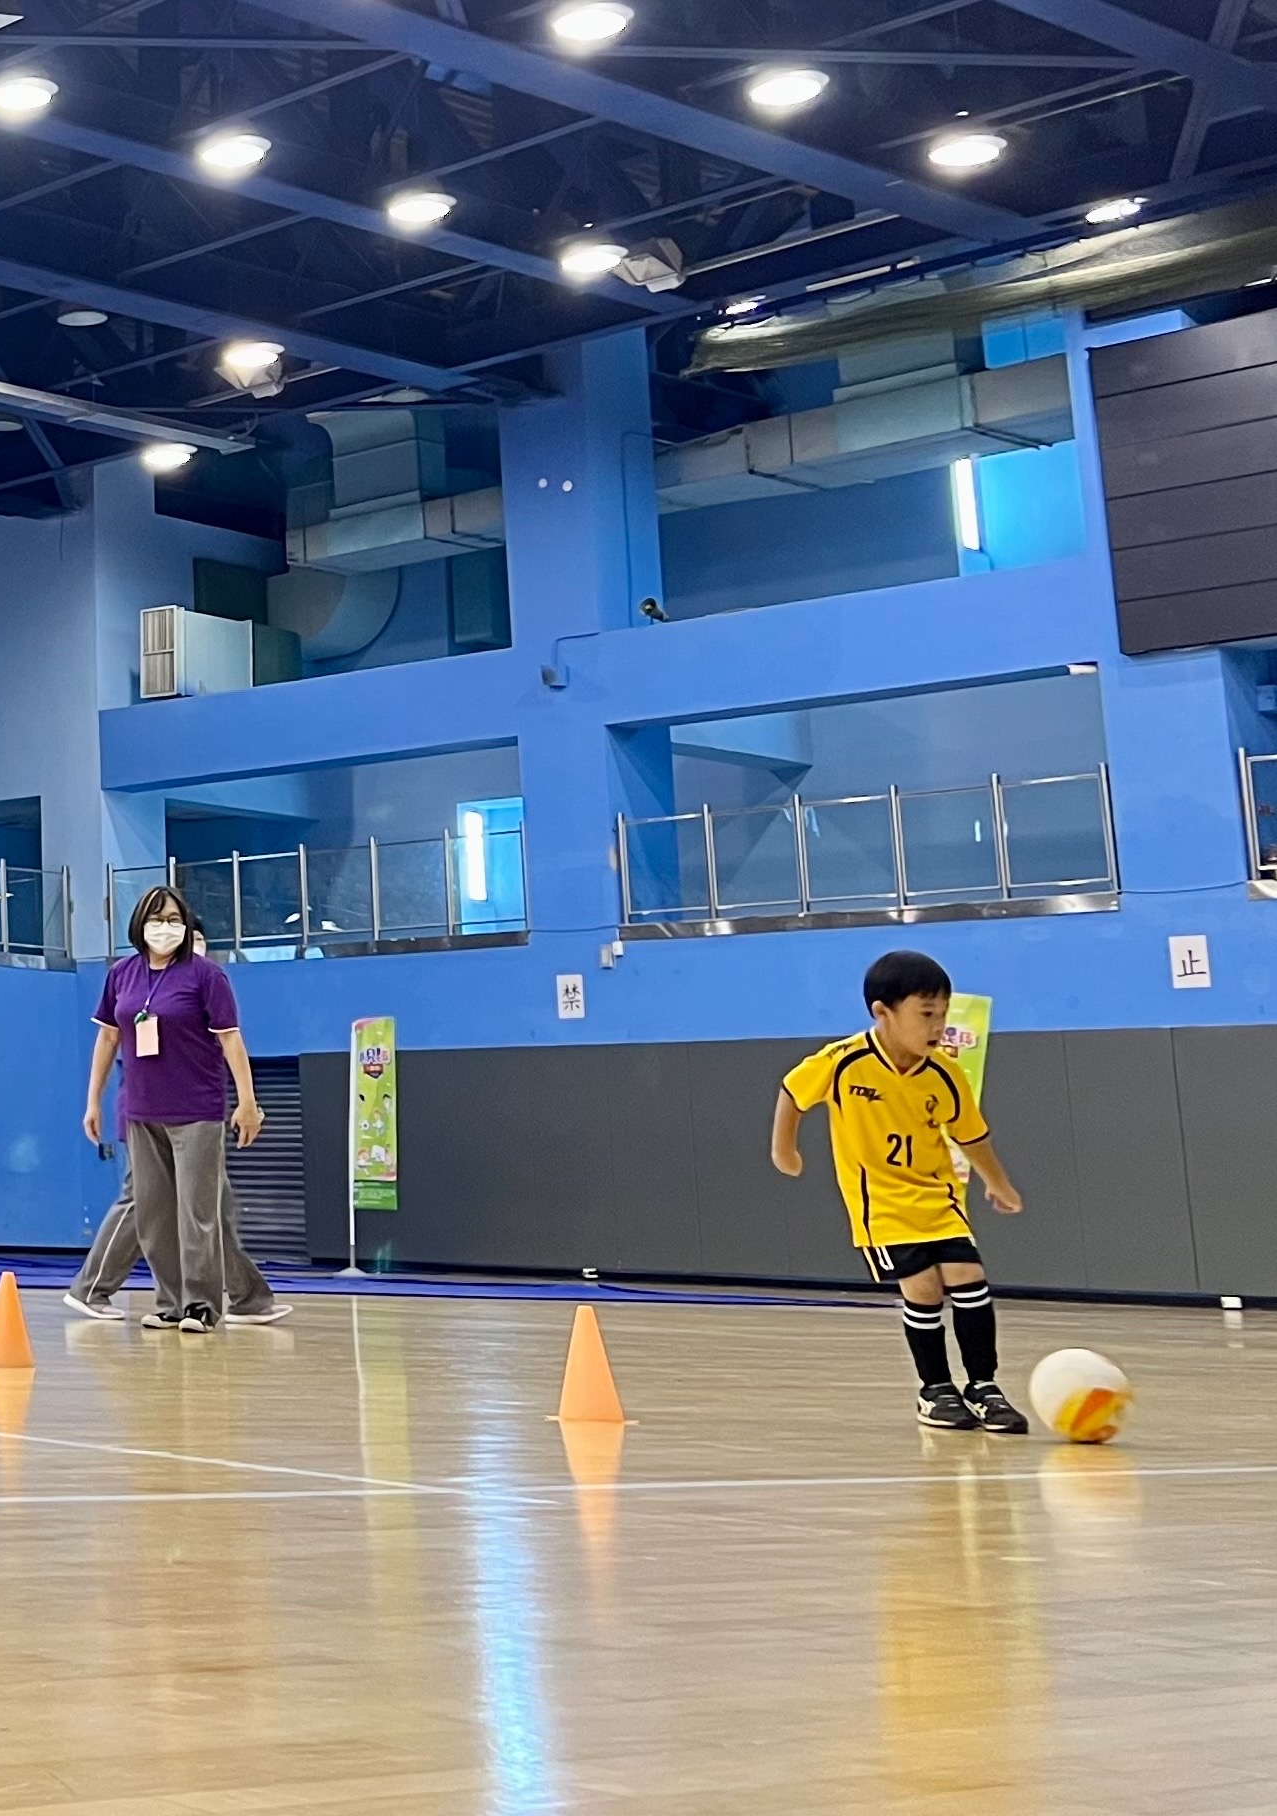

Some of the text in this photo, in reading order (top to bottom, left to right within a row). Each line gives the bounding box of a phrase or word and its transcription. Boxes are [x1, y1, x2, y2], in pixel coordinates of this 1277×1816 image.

[1176, 949, 1207, 978] 止
[562, 983, 581, 1011] 禁
[886, 1133, 913, 1168] 21
